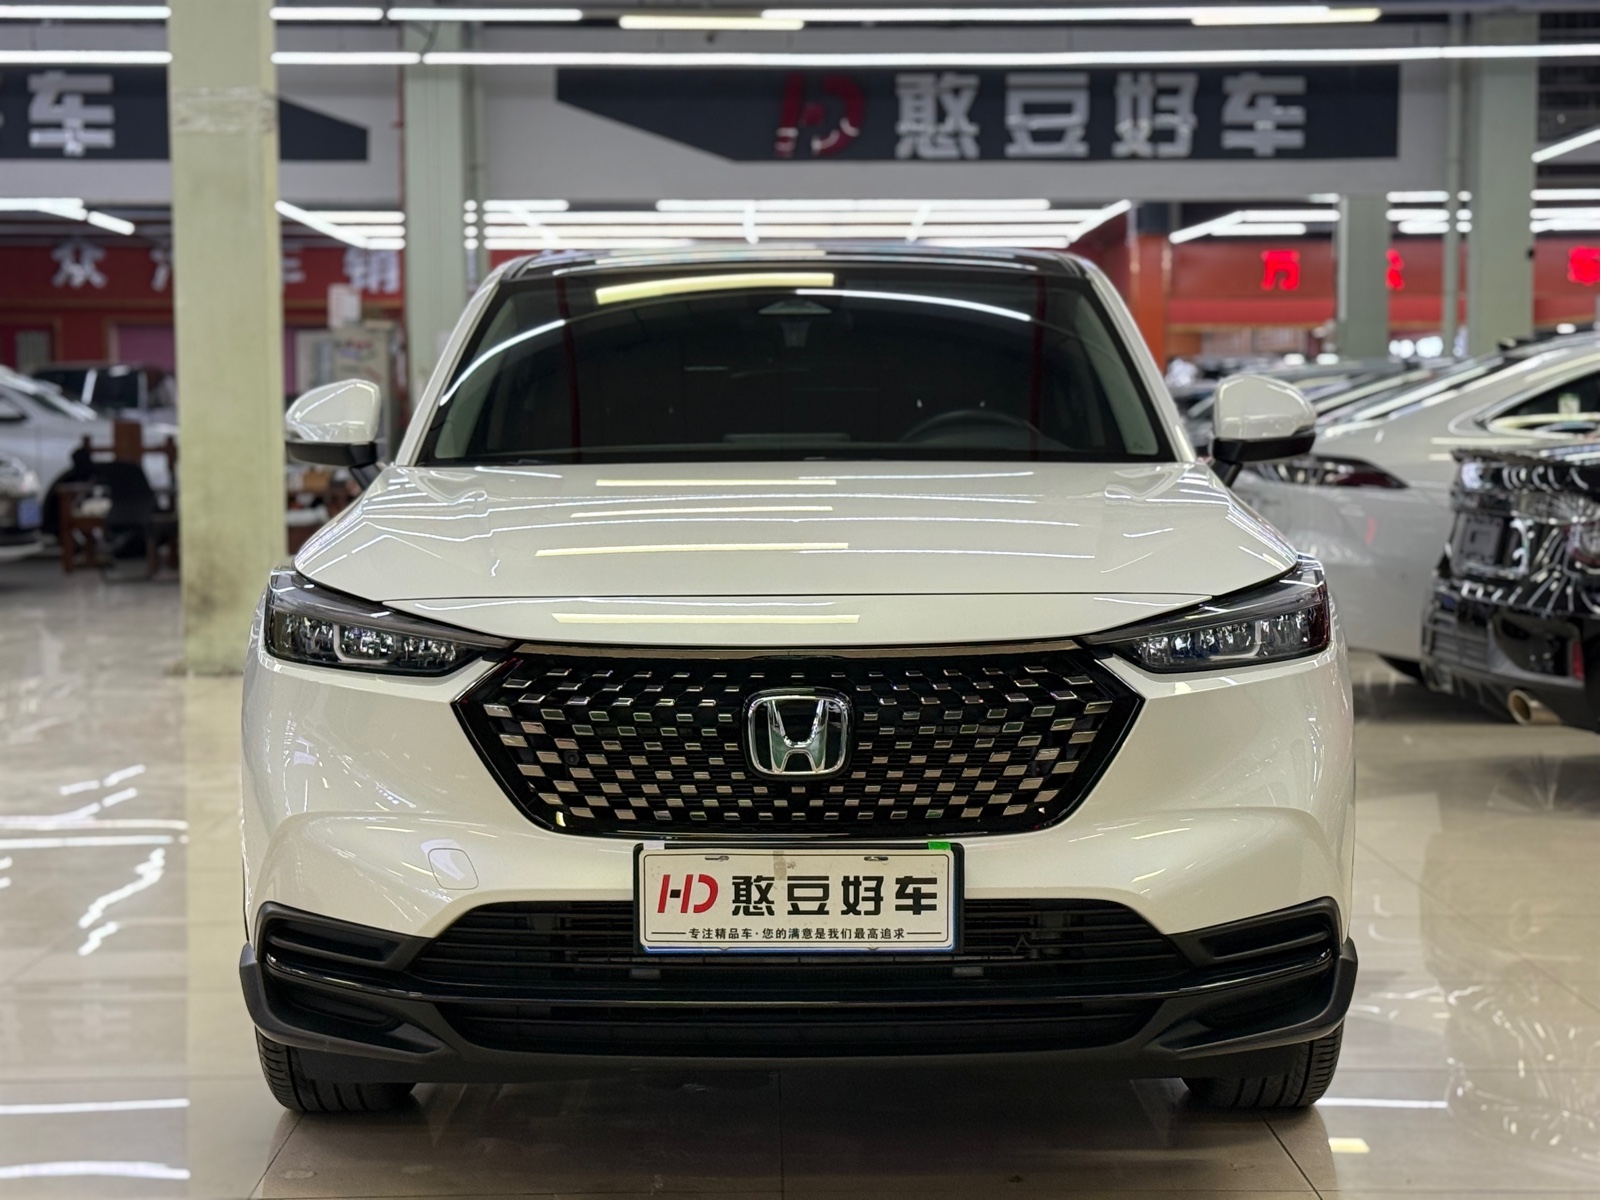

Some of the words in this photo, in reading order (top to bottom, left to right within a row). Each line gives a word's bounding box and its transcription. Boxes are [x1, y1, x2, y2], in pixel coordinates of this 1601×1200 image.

[894, 71, 1307, 160] 憨豆好车
[657, 873, 719, 914] HD
[731, 875, 938, 916] 憨豆好车
